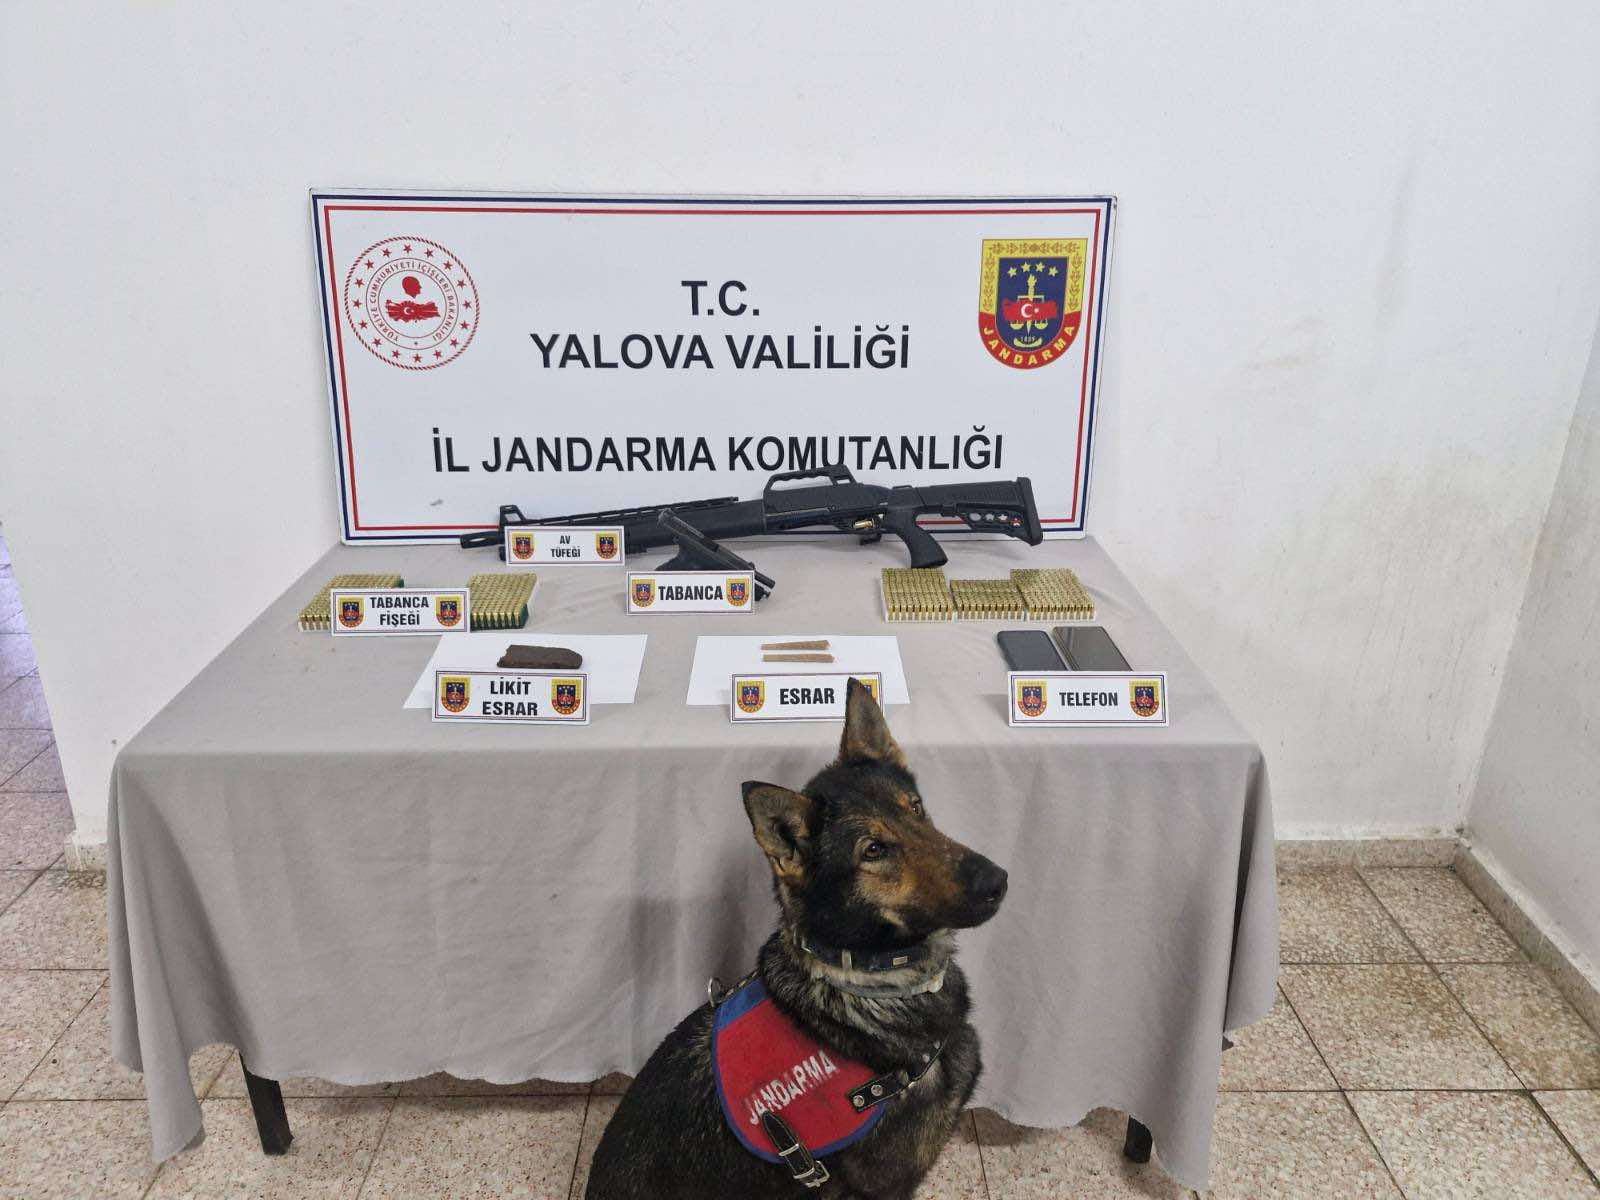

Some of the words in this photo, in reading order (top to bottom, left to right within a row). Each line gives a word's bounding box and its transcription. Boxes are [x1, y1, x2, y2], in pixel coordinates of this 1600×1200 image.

[681, 280, 760, 316] T.C.
[530, 334, 714, 370] YALOVA
[725, 324, 909, 369] VALİLİĞİ
[984, 327, 1075, 365] JANDARMA
[432, 427, 470, 472] İL
[481, 436, 717, 473] JANDARMA
[728, 425, 1003, 472] KOMUTANLIĞI
[559, 535, 571, 545] AV
[550, 546, 581, 558] TÜFEĞİ
[657, 585, 724, 601] TABANCA
[369, 596, 430, 609] TABANCA
[379, 610, 420, 627] FİŞEĞİ
[489, 676, 532, 695] LİKİT
[779, 687, 835, 705] ESRAR
[1058, 692, 1118, 707] TELEFON
[482, 701, 538, 717] ESRAR
[745, 1050, 839, 1126] JANDARMA
